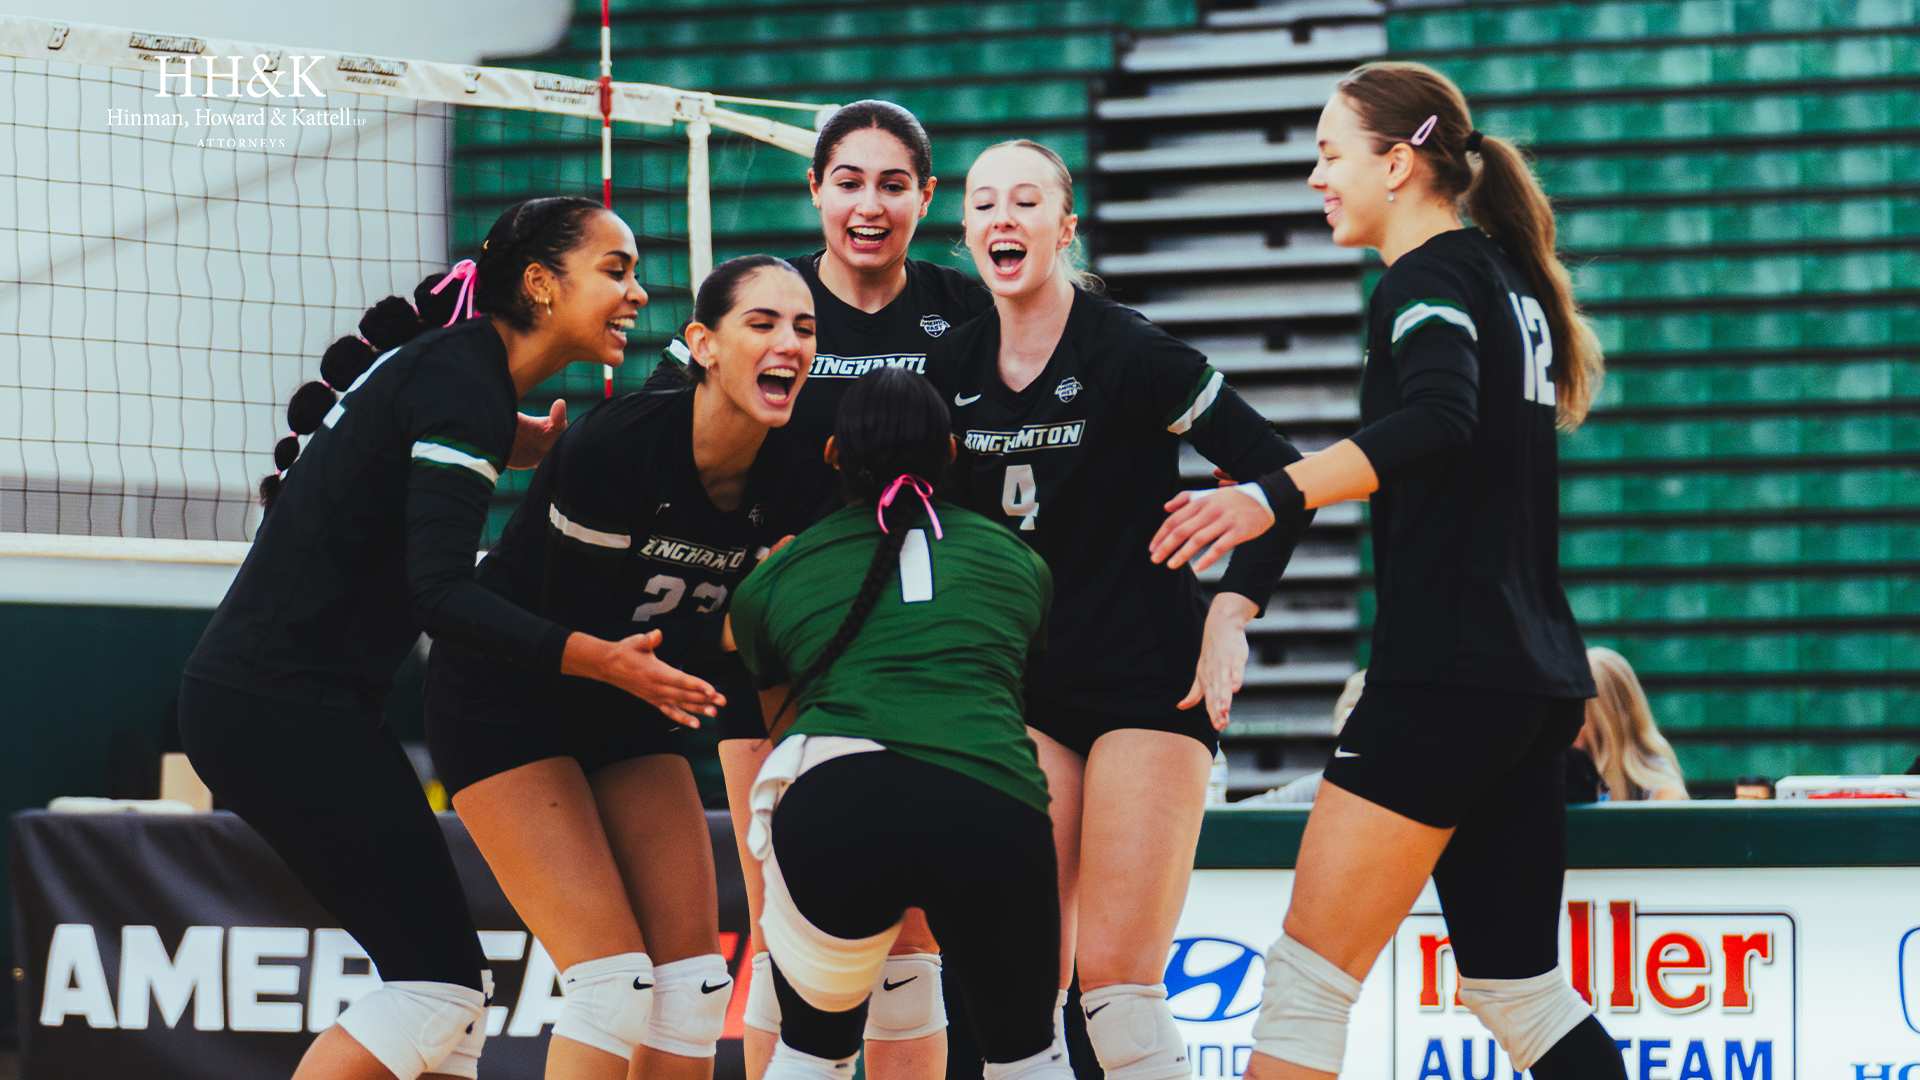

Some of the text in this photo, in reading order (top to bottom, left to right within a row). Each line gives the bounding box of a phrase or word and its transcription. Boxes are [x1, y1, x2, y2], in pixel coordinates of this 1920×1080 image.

[1509, 292, 1556, 406] 12
[1002, 464, 1040, 530] 4
[899, 528, 934, 603] 1
